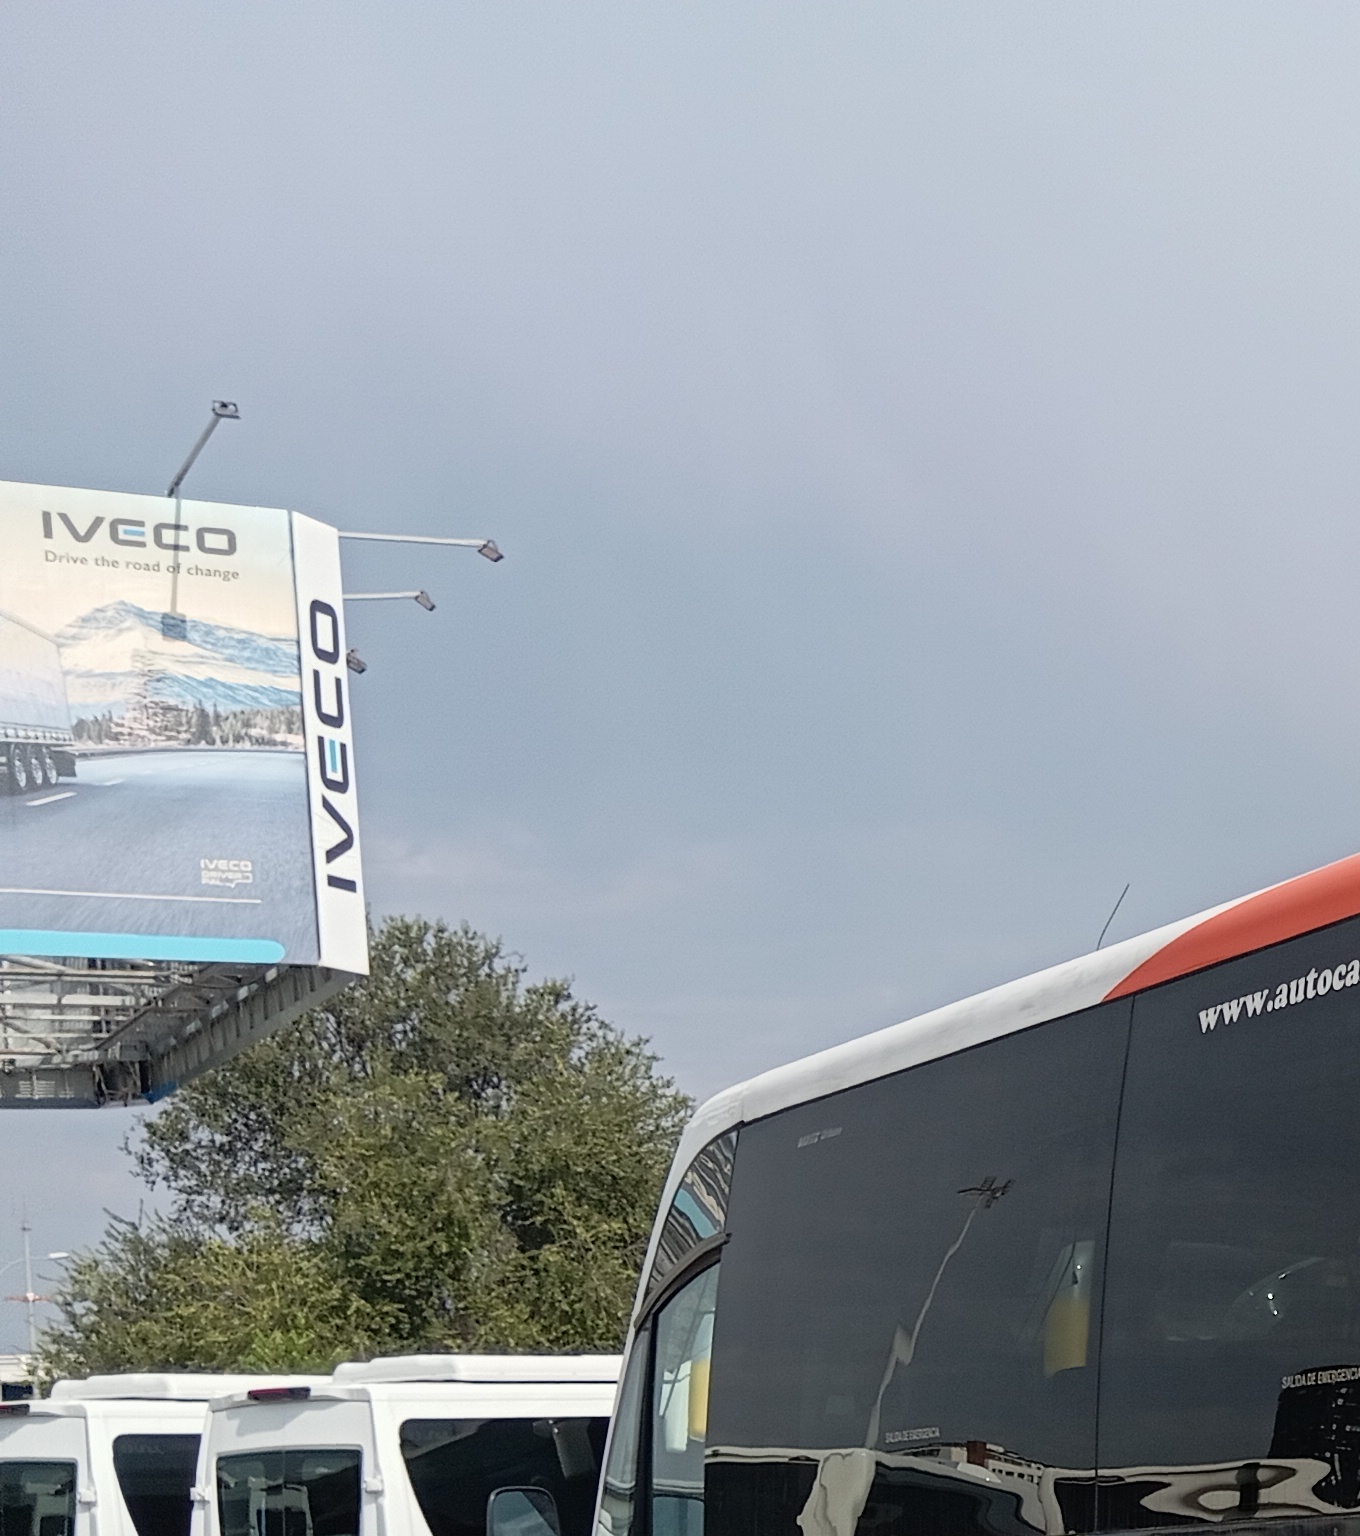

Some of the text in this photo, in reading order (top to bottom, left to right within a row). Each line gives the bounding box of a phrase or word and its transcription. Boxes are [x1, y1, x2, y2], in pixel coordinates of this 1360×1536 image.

[42, 511, 237, 556] IVECO
[44, 550, 240, 581] Drive the road of change
[309, 598, 357, 893] IVECO
[200, 859, 252, 871] IVECO
